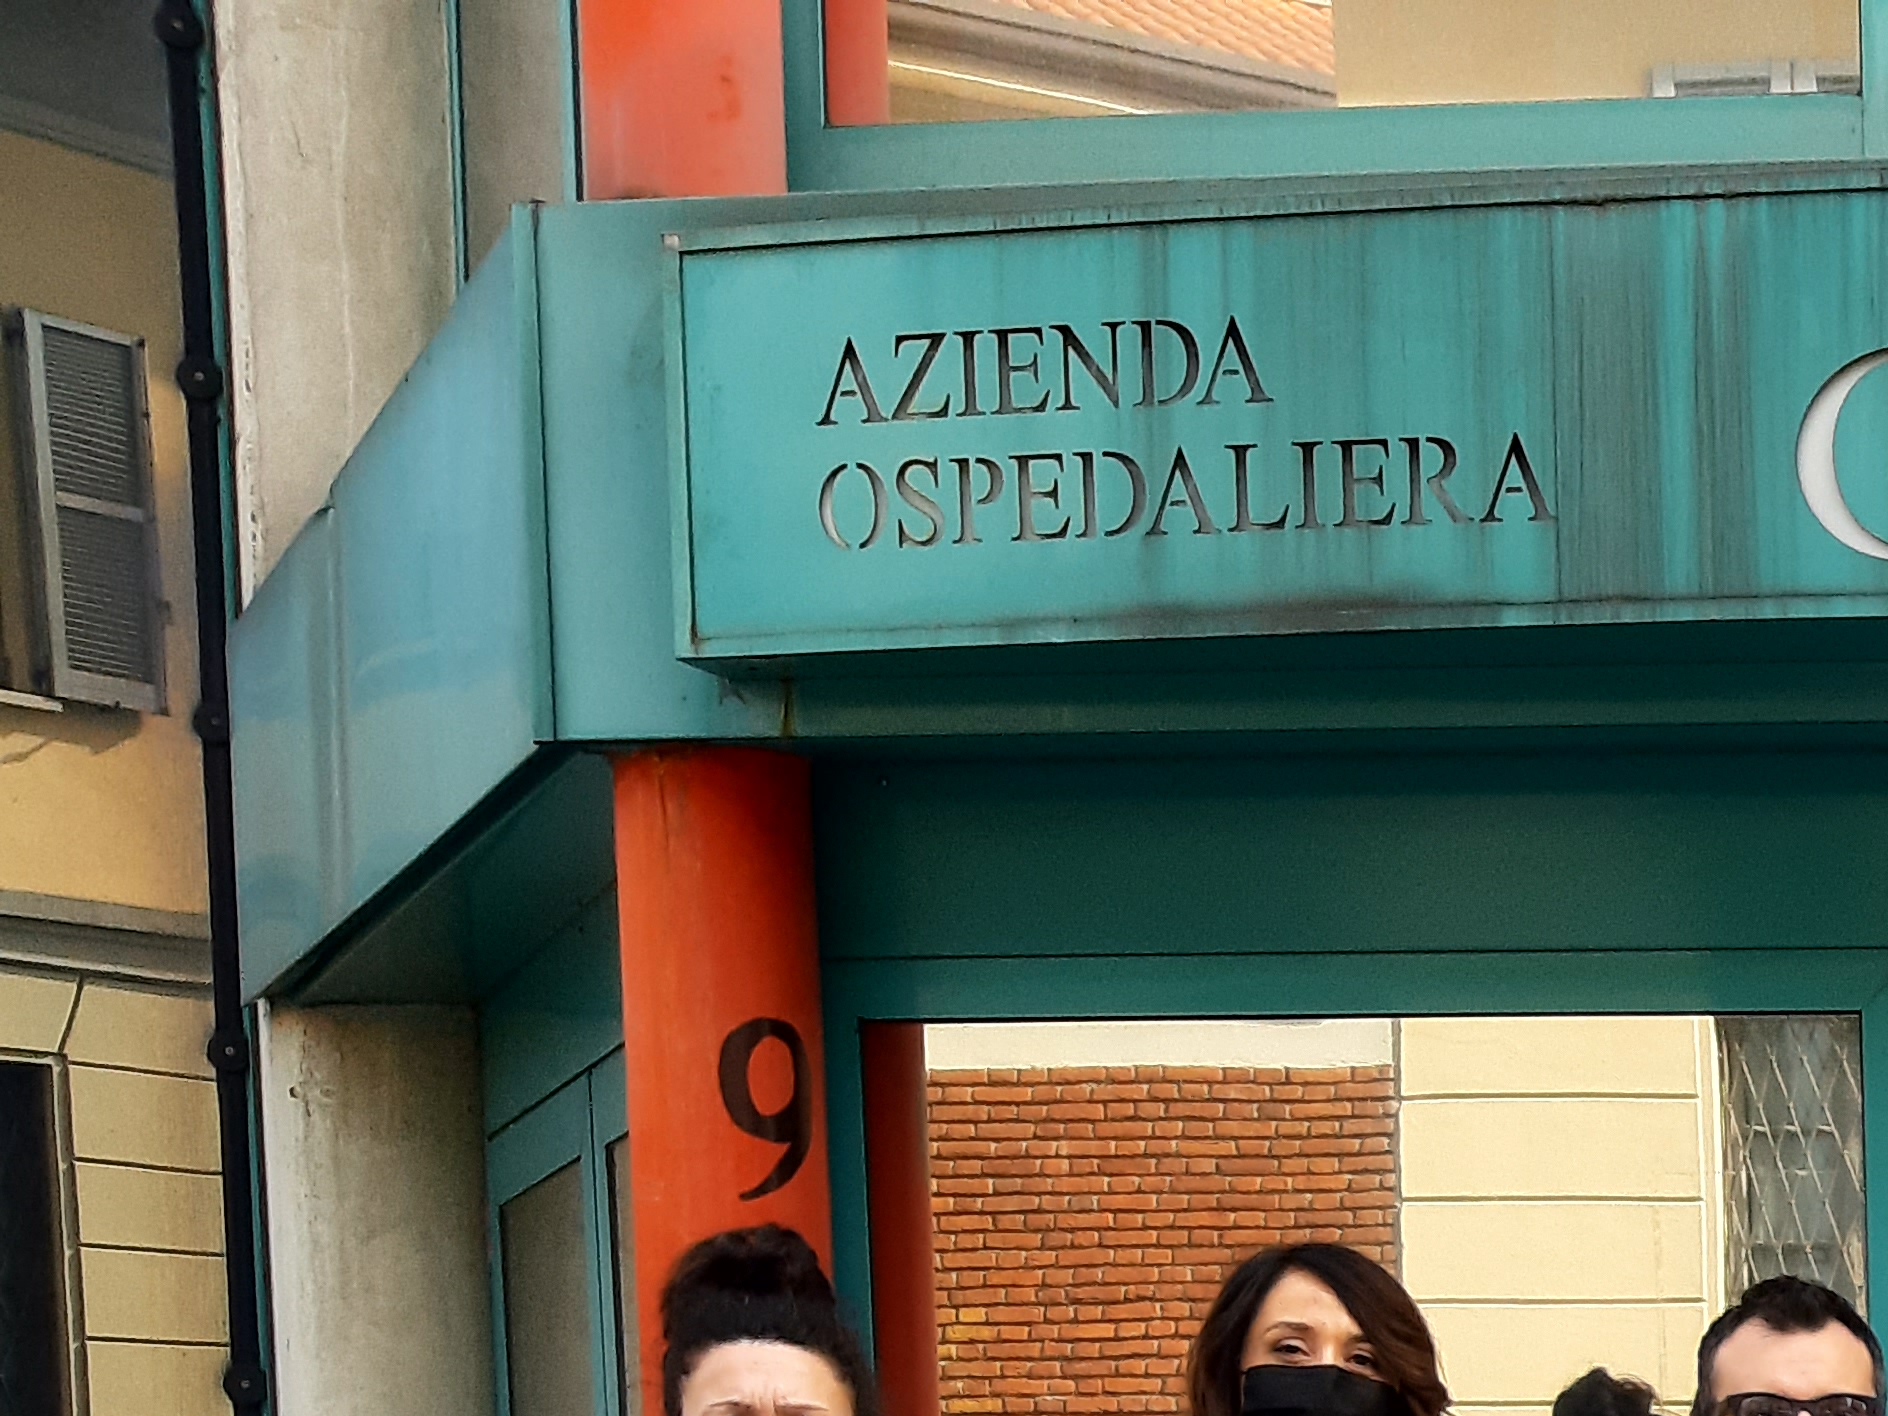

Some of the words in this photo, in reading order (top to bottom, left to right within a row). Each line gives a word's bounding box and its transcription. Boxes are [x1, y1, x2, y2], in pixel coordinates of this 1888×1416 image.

[816, 313, 1275, 428] AZIENDA
[818, 431, 1556, 555] OSPEDALIERA
[717, 1016, 814, 1202] 9
